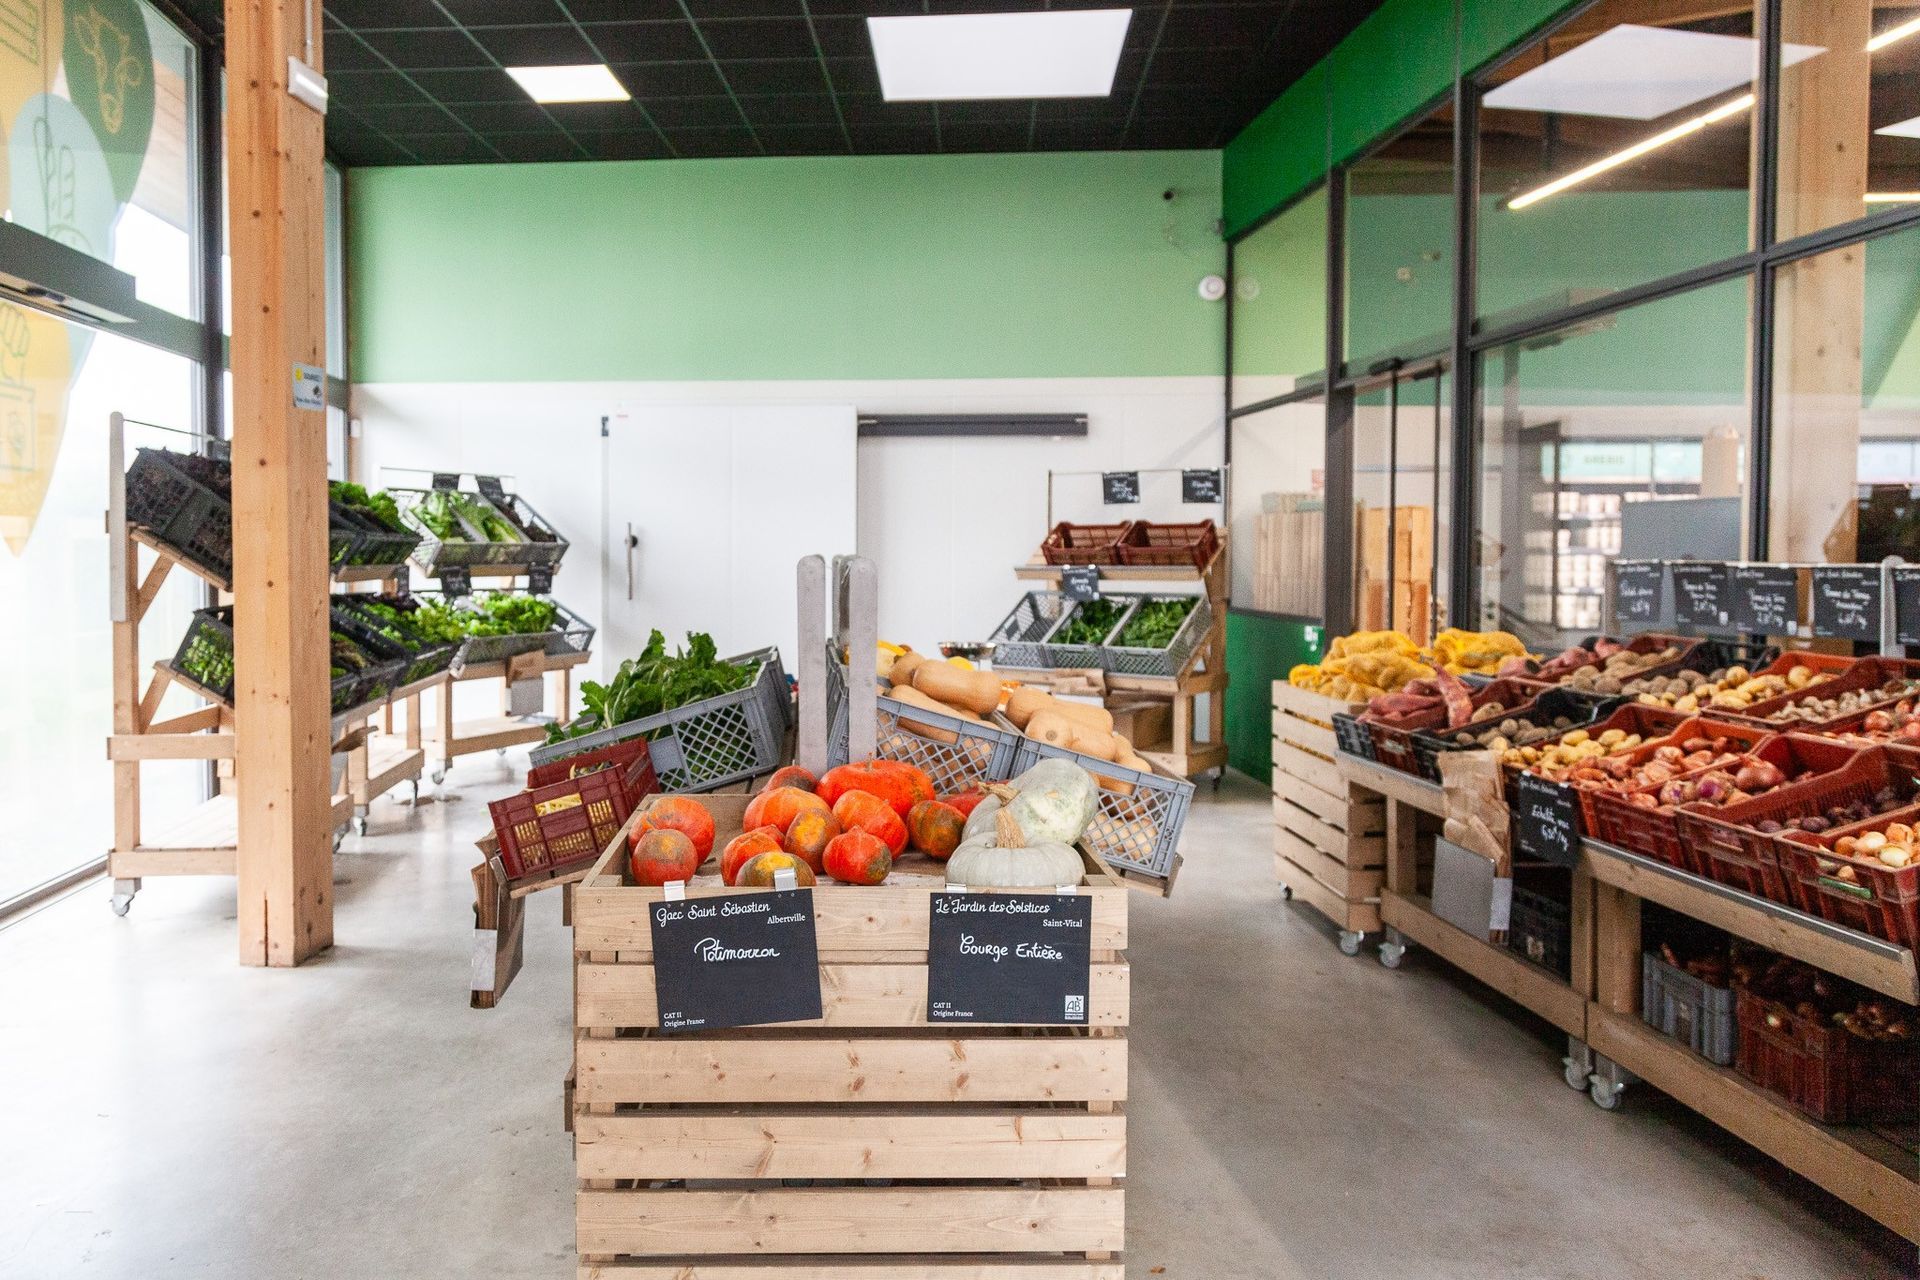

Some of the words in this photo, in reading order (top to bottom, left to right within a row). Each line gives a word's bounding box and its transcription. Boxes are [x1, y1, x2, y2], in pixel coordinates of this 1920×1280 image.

[935, 898, 950, 914] Le
[951, 899, 987, 914] Jardin
[988, 901, 1006, 913] des
[1005, 899, 1051, 914] Solstices
[656, 907, 684, 928] Gaec
[687, 904, 718, 920] Saint
[721, 901, 771, 917] Sébastien
[767, 912, 806, 924] Albertville
[1042, 918, 1083, 928] Saint-Vital
[693, 937, 781, 962] Potimarron
[960, 933, 1009, 963] Courge
[1015, 942, 1064, 960] Entière
[1066, 1000, 1081, 1012] AB
[933, 1010, 954, 1018] Origine
[664, 1019, 686, 1028] Origine
[686, 1018, 705, 1026] France
